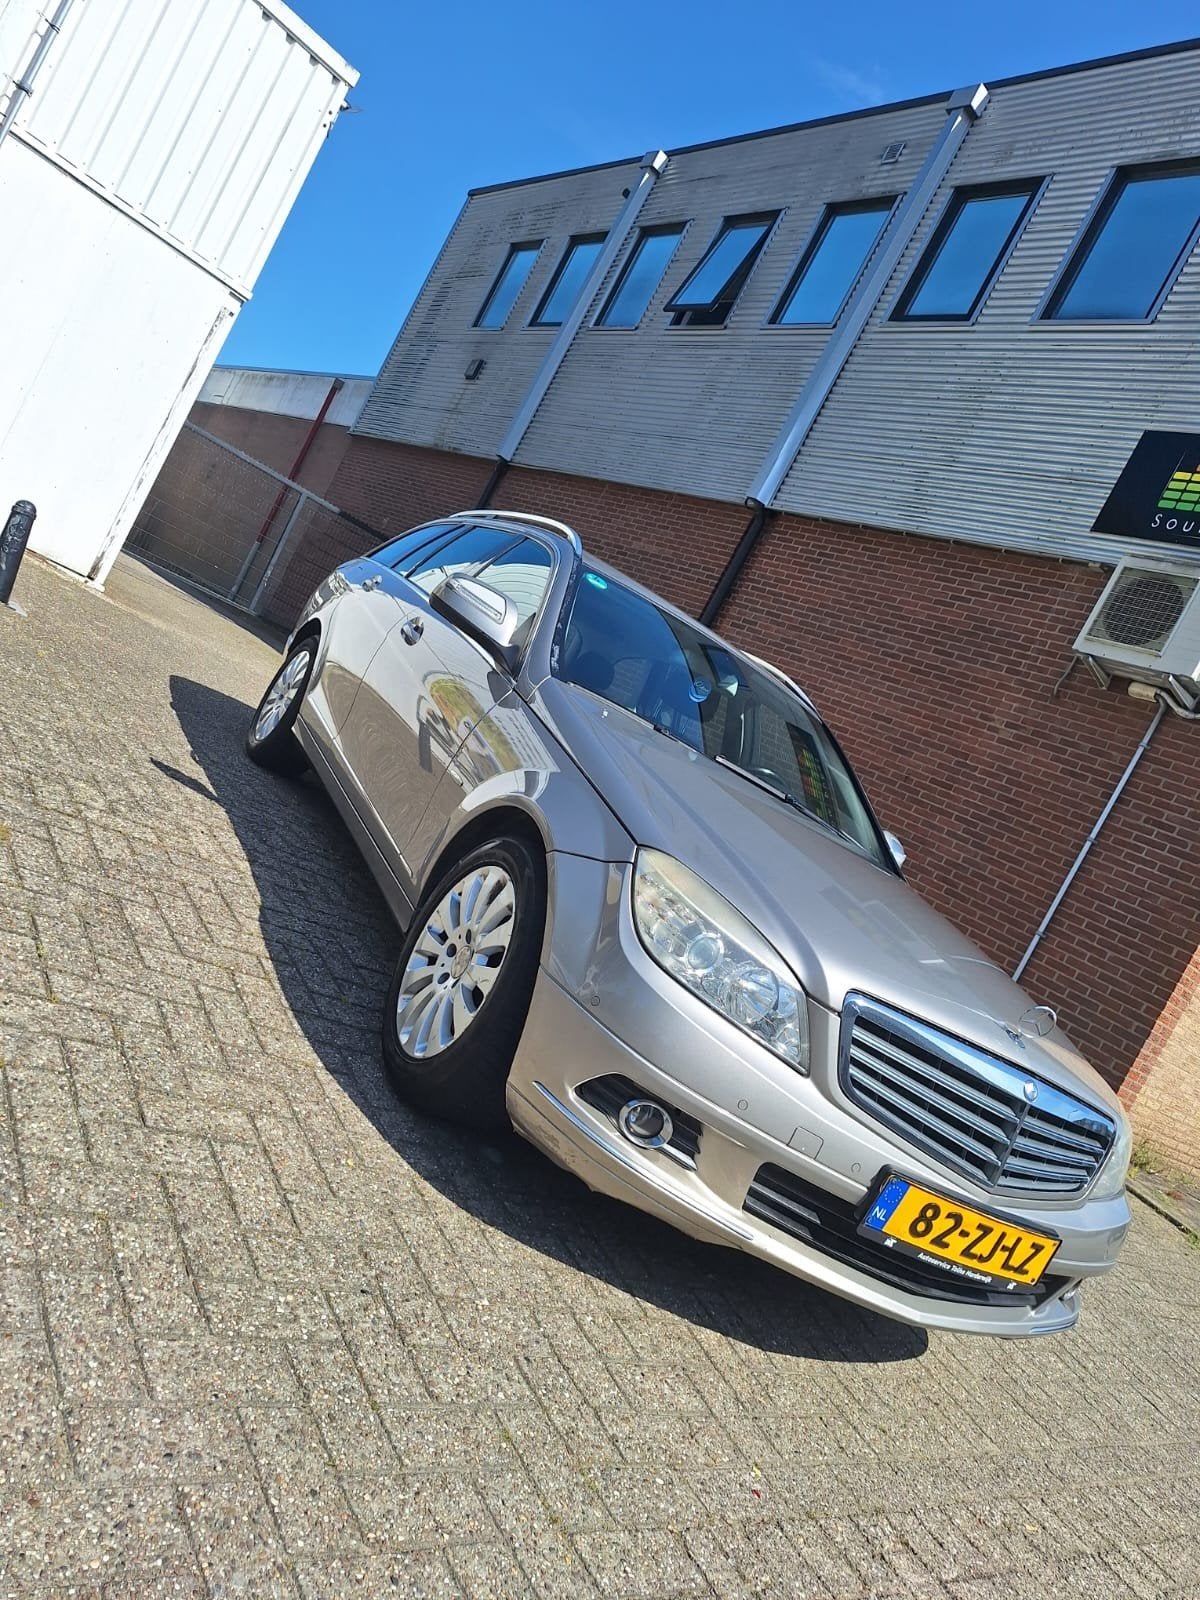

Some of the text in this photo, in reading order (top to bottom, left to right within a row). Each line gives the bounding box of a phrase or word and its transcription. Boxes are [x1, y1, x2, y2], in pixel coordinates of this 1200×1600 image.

[1151, 513, 1200, 533] SOU
[872, 1206, 887, 1221] NL
[908, 1203, 1045, 1275] 82-ZJ-LZ
